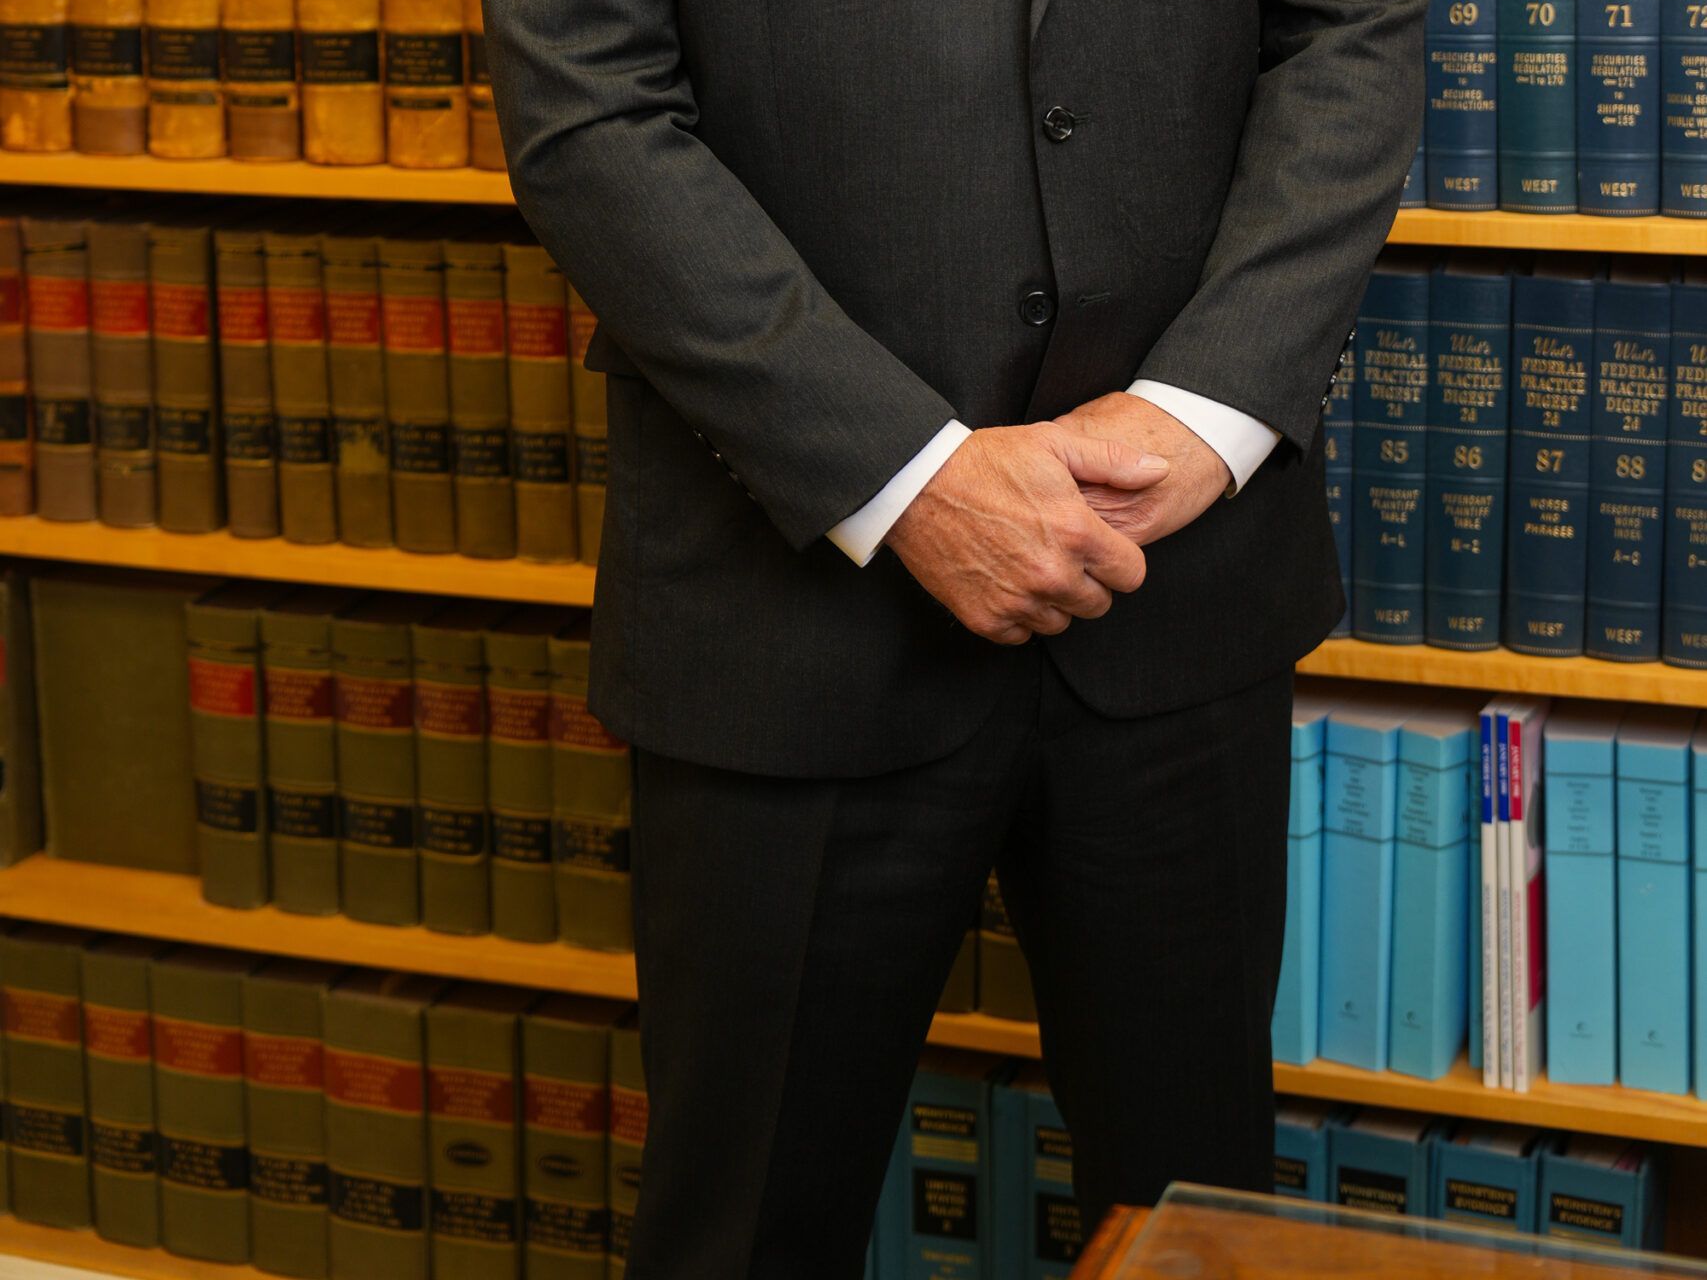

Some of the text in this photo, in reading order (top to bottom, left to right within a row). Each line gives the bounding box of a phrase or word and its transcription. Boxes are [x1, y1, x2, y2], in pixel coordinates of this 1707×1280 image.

[1450, 3, 1478, 26] 69
[1526, 3, 1555, 26] 70
[1605, 5, 1633, 27] 71
[1597, 104, 1642, 115] SHIPPING
[1522, 179, 1558, 193] WEST
[1521, 359, 1586, 378] FEDERAL
[1600, 363, 1666, 380] FEDERAL
[1520, 376, 1586, 394] PRACTICE
[1600, 380, 1666, 397] PRACTICE
[1526, 394, 1578, 412] DIGEST
[1605, 398, 1658, 415] DIGEST
[1543, 412, 1560, 426] 2d
[1623, 417, 1640, 431] 2d
[1536, 450, 1564, 472] 87
[1616, 455, 1646, 477] 88
[1605, 628, 1641, 644] WEST
